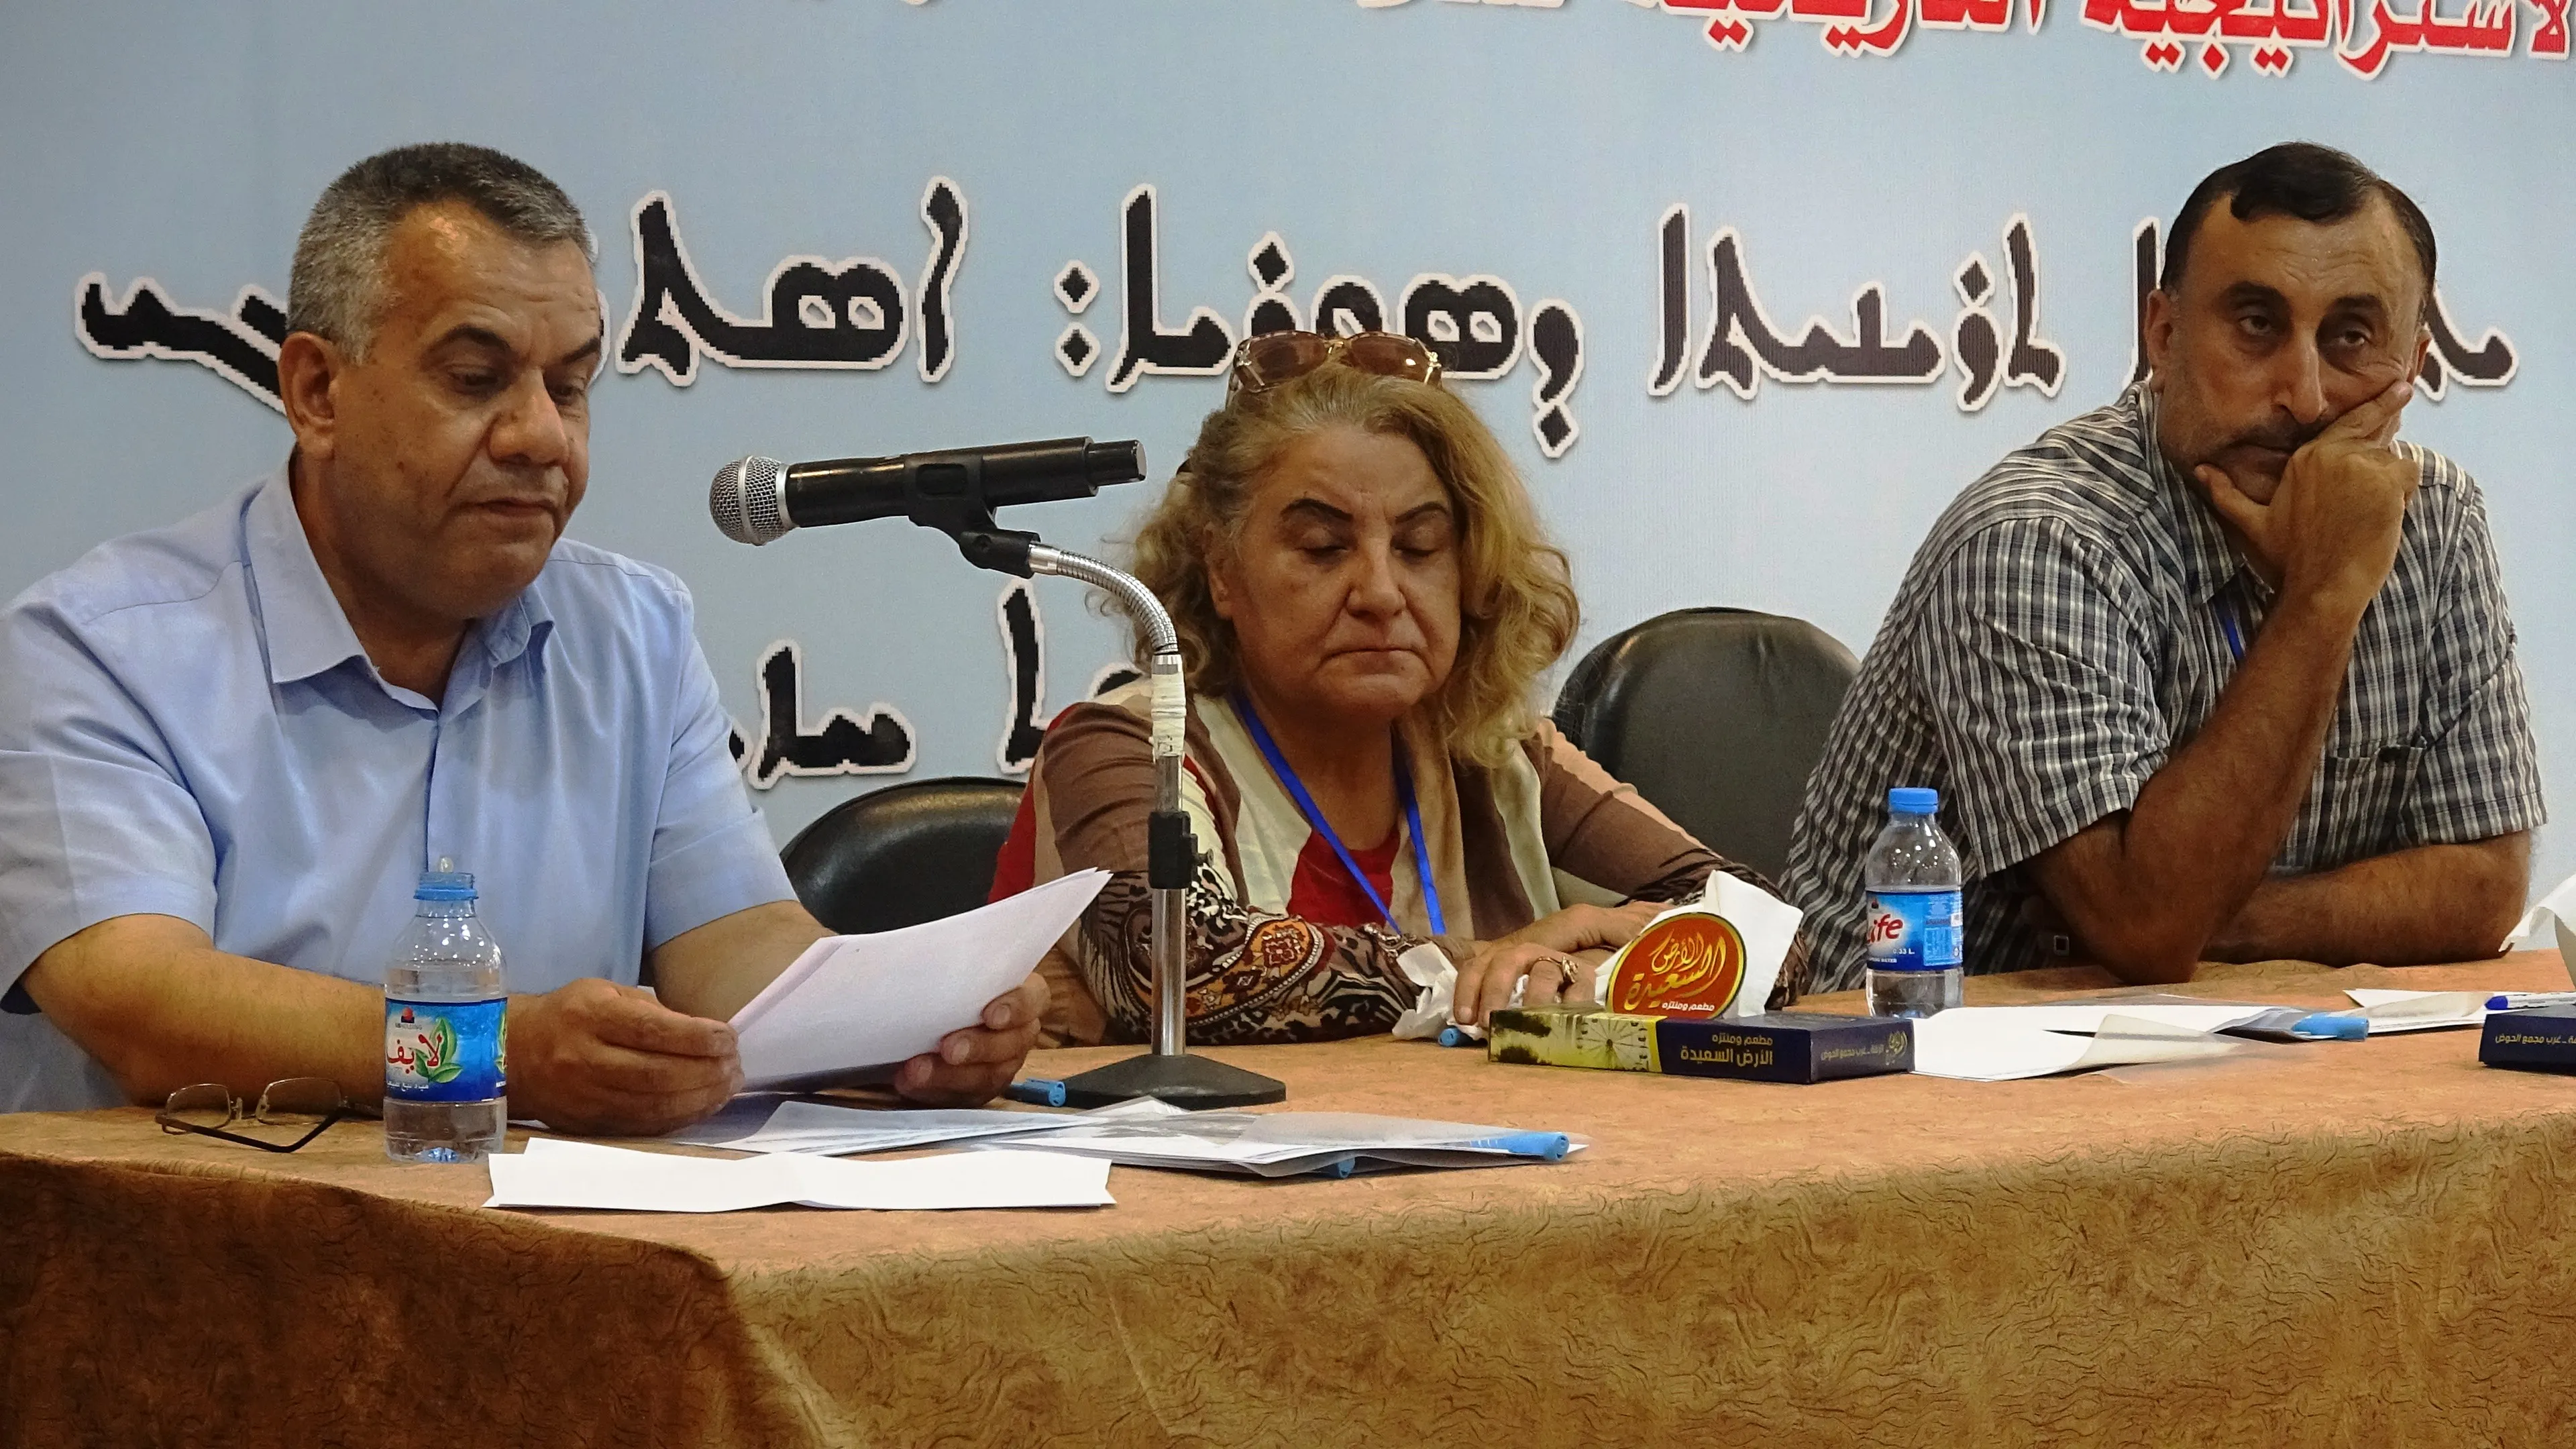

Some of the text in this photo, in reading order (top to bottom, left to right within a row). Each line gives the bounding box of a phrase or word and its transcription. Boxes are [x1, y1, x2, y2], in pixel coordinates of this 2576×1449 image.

[1868, 914, 1904, 944] ife
[1688, 1002, 1715, 1012] مطعم
[1712, 1032, 1773, 1046] مطعم ومنتزه
[1680, 1045, 1773, 1068] الأرض السعيدة
